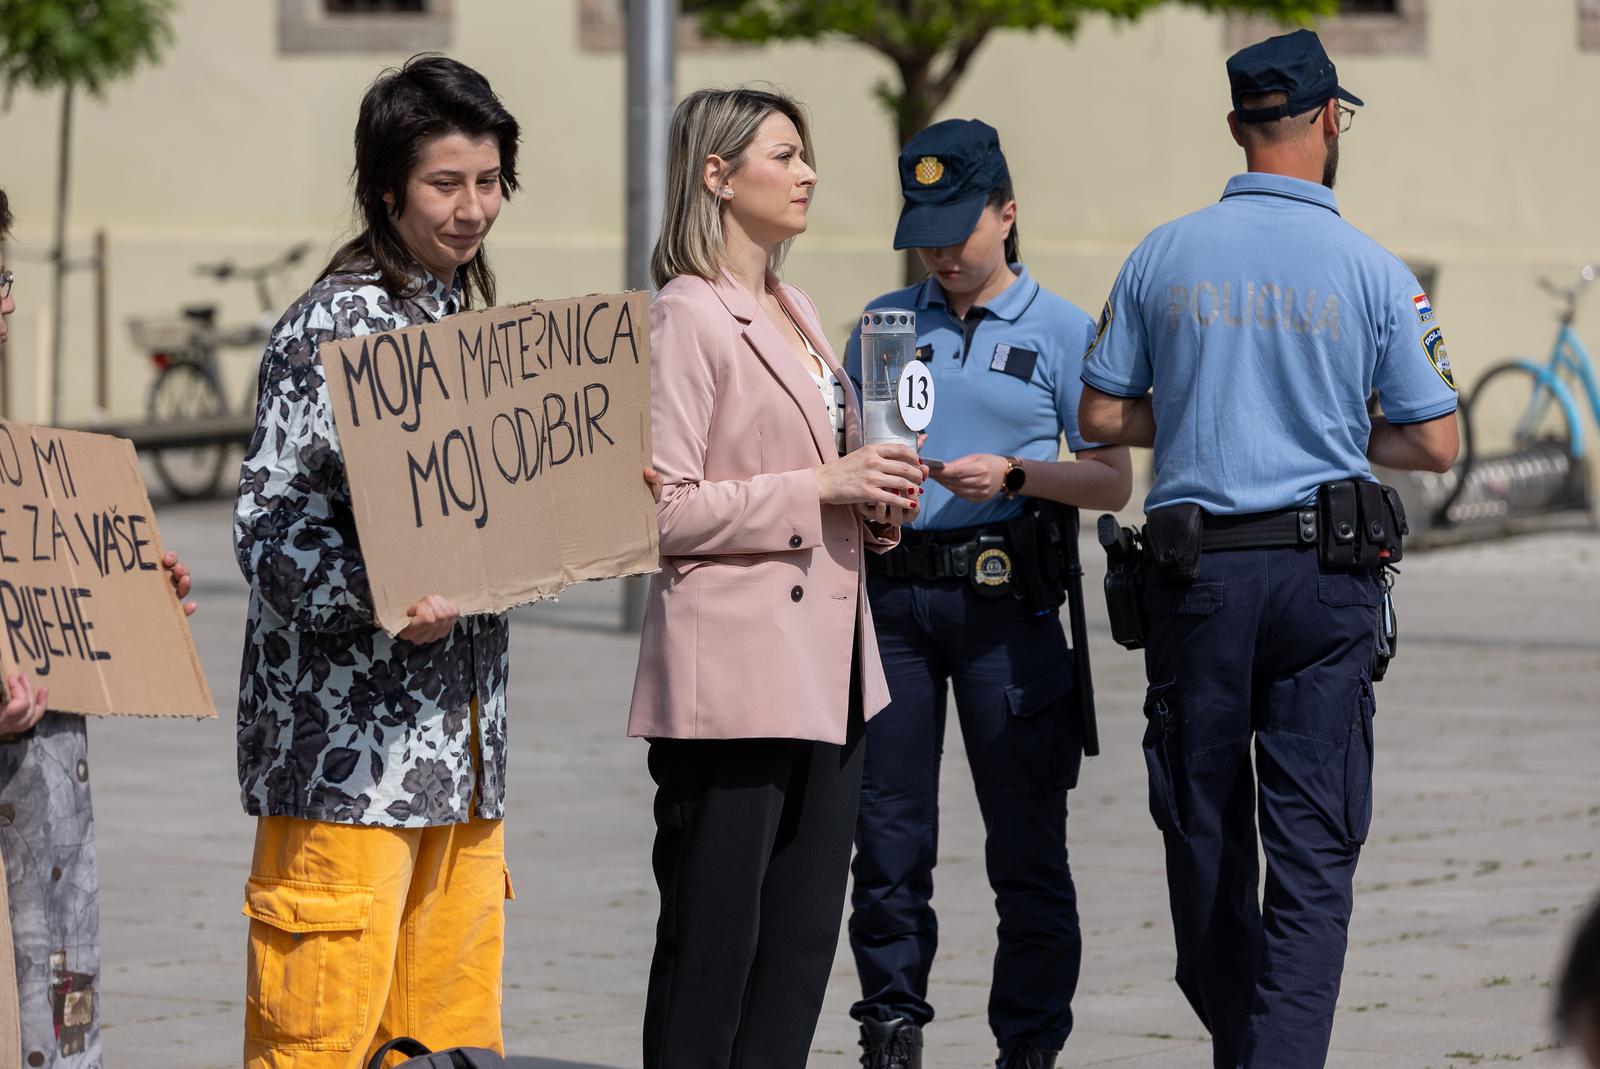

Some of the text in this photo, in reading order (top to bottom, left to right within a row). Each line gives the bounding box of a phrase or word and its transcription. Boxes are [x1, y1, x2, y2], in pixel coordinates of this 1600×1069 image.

[1168, 281, 1341, 341] POLICIJA
[339, 301, 639, 432] MOJA MATERNICA
[906, 374, 928, 410] 13
[0, 423, 77, 499] O MI
[406, 426, 488, 529] MOJ
[22, 504, 79, 565] ZA
[74, 504, 158, 578] VAŠE
